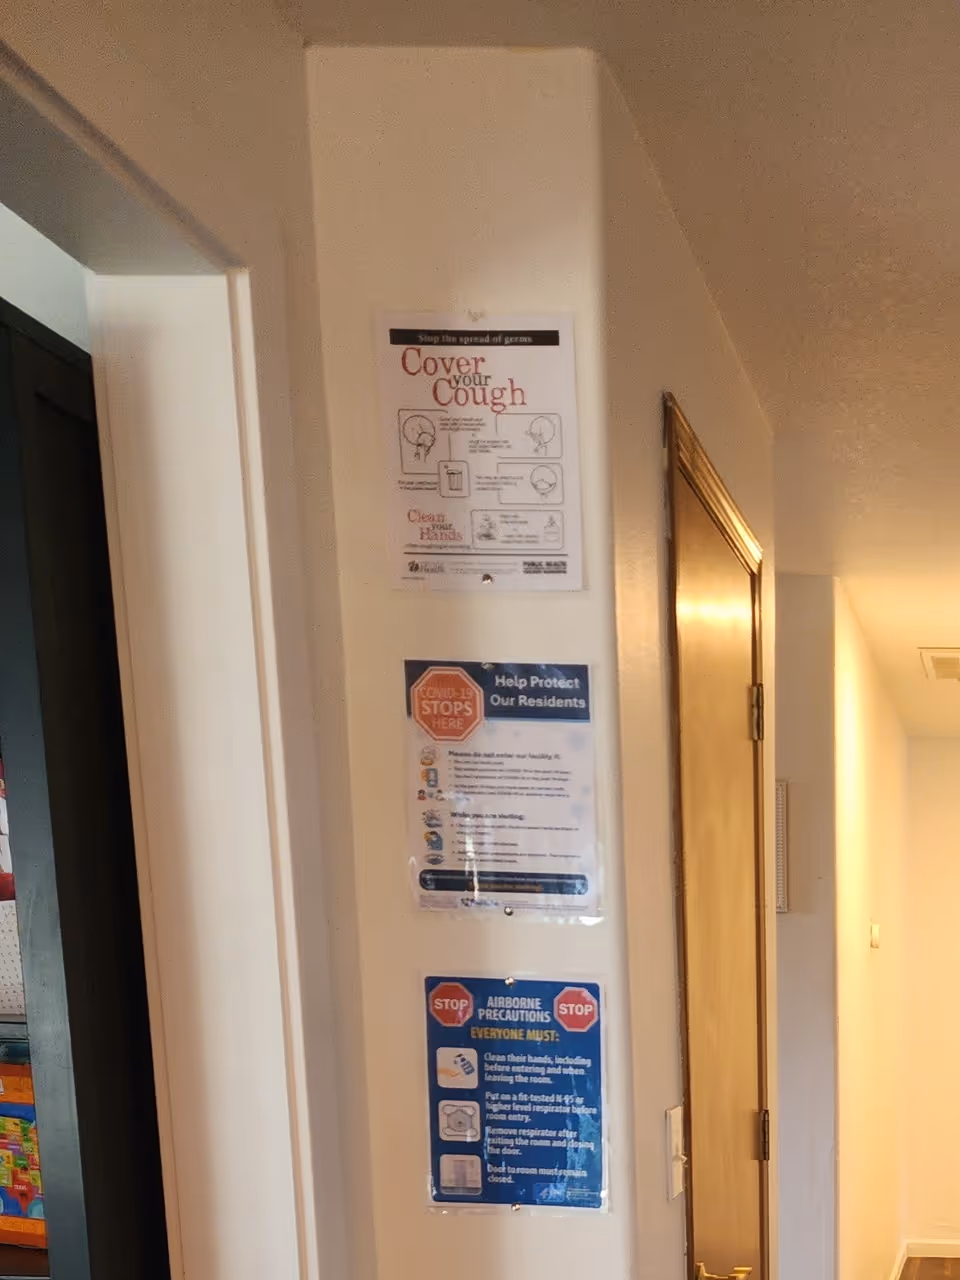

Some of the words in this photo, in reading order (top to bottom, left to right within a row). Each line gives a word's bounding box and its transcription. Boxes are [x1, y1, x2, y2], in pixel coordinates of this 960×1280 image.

[418, 335, 440, 345] Stop
[442, 335, 457, 343] the
[459, 334, 490, 345] spread
[493, 334, 502, 343] of
[504, 336, 533, 345] germs
[401, 347, 486, 376] Cover
[453, 374, 492, 388] your
[432, 377, 527, 413] Cough
[407, 509, 445, 522] Clean
[431, 523, 453, 531] your
[419, 527, 463, 541] Hands
[495, 675, 527, 690] Help
[530, 675, 580, 689] Protect
[418, 687, 473, 699] COVID-19
[490, 694, 515, 706] Our
[517, 695, 587, 709] Residents
[421, 700, 473, 717] STOPS
[431, 717, 465, 730] HERE
[434, 998, 469, 1010] STOP
[487, 996, 542, 1010] AIRBORNE
[558, 1003, 594, 1016] STOP
[478, 1008, 552, 1023] PRECAUTIONS
[470, 1027, 525, 1040] EVERYONE
[526, 1029, 560, 1042] MUST:
[484, 1052, 506, 1062] Clean
[507, 1053, 526, 1063] their
[527, 1054, 554, 1065] hands,
[555, 1055, 592, 1068] including
[484, 1062, 511, 1071] before
[511, 1064, 546, 1076] entering
[546, 1065, 562, 1074] and
[562, 1065, 585, 1075] when
[484, 1072, 514, 1084] leaving
[514, 1073, 529, 1083] the
[529, 1076, 553, 1084] room.
[485, 1091, 499, 1101] Put
[500, 1093, 511, 1101] on
[518, 1092, 555, 1102] fit-tested
[556, 1094, 574, 1104] N-95
[575, 1096, 584, 1104] or
[485, 1101, 511, 1112] higher
[512, 1102, 531, 1112] level
[532, 1104, 570, 1114] respirator
[571, 1105, 598, 1115] before
[508, 1113, 532, 1123] entry.
[487, 1126, 517, 1135] Remove
[518, 1128, 557, 1138] respirator
[558, 1129, 578, 1138] after
[487, 1136, 514, 1147] exiting
[515, 1137, 529, 1146] the
[529, 1139, 551, 1147] room
[551, 1139, 567, 1147] and
[567, 1139, 595, 1152] closing
[487, 1146, 501, 1154] the
[501, 1146, 523, 1155] door.
[487, 1174, 515, 1183] closed.
[507, 1166, 516, 1174] to
[516, 1167, 537, 1175] room
[538, 1168, 558, 1176] must
[559, 1168, 587, 1178] remain
